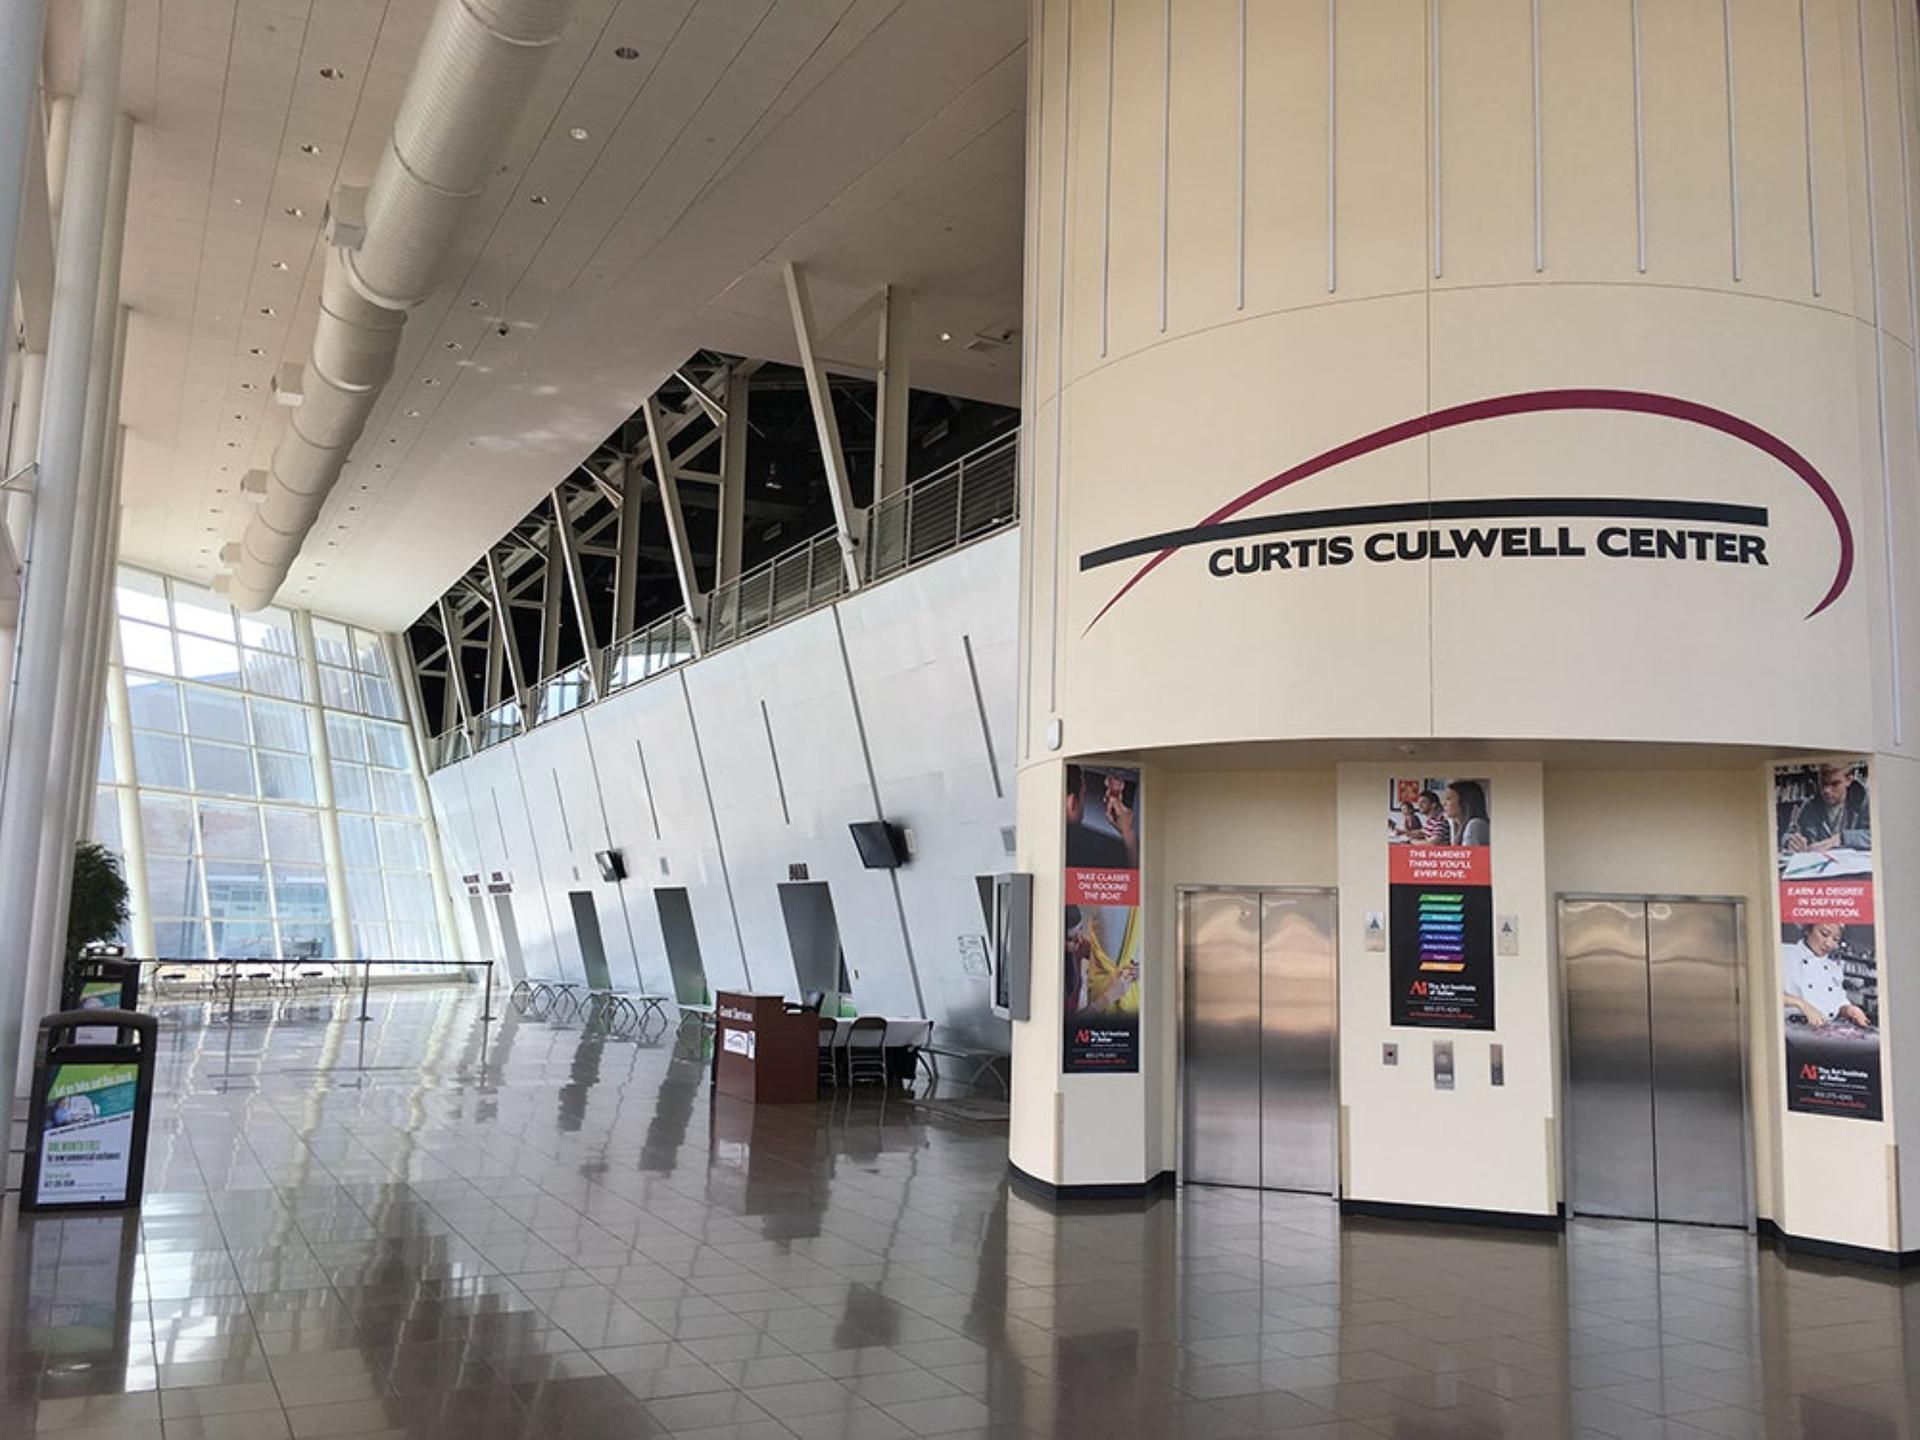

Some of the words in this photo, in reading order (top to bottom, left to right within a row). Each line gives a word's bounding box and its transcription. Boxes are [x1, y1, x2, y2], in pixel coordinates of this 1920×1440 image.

[1208, 536, 1353, 577] CURTIS
[1363, 527, 1585, 562] CULWELL
[1597, 525, 1769, 566] CENTER
[1408, 849, 1426, 858] THE
[1428, 849, 1472, 859] HARDEST
[1408, 859, 1438, 868] THING
[1439, 860, 1472, 869] YOU'LL
[1076, 872, 1095, 881] TAKE
[1097, 873, 1130, 882] CLASSES
[1413, 869, 1437, 878] EVER
[1078, 881, 1091, 890] ON
[1083, 891, 1099, 899] THE
[1787, 887, 1815, 896] EARN
[1816, 887, 1824, 896] A
[1825, 887, 1865, 896] DEGREE
[1798, 898, 1809, 906] IN
[1811, 898, 1855, 906] DEFYING
